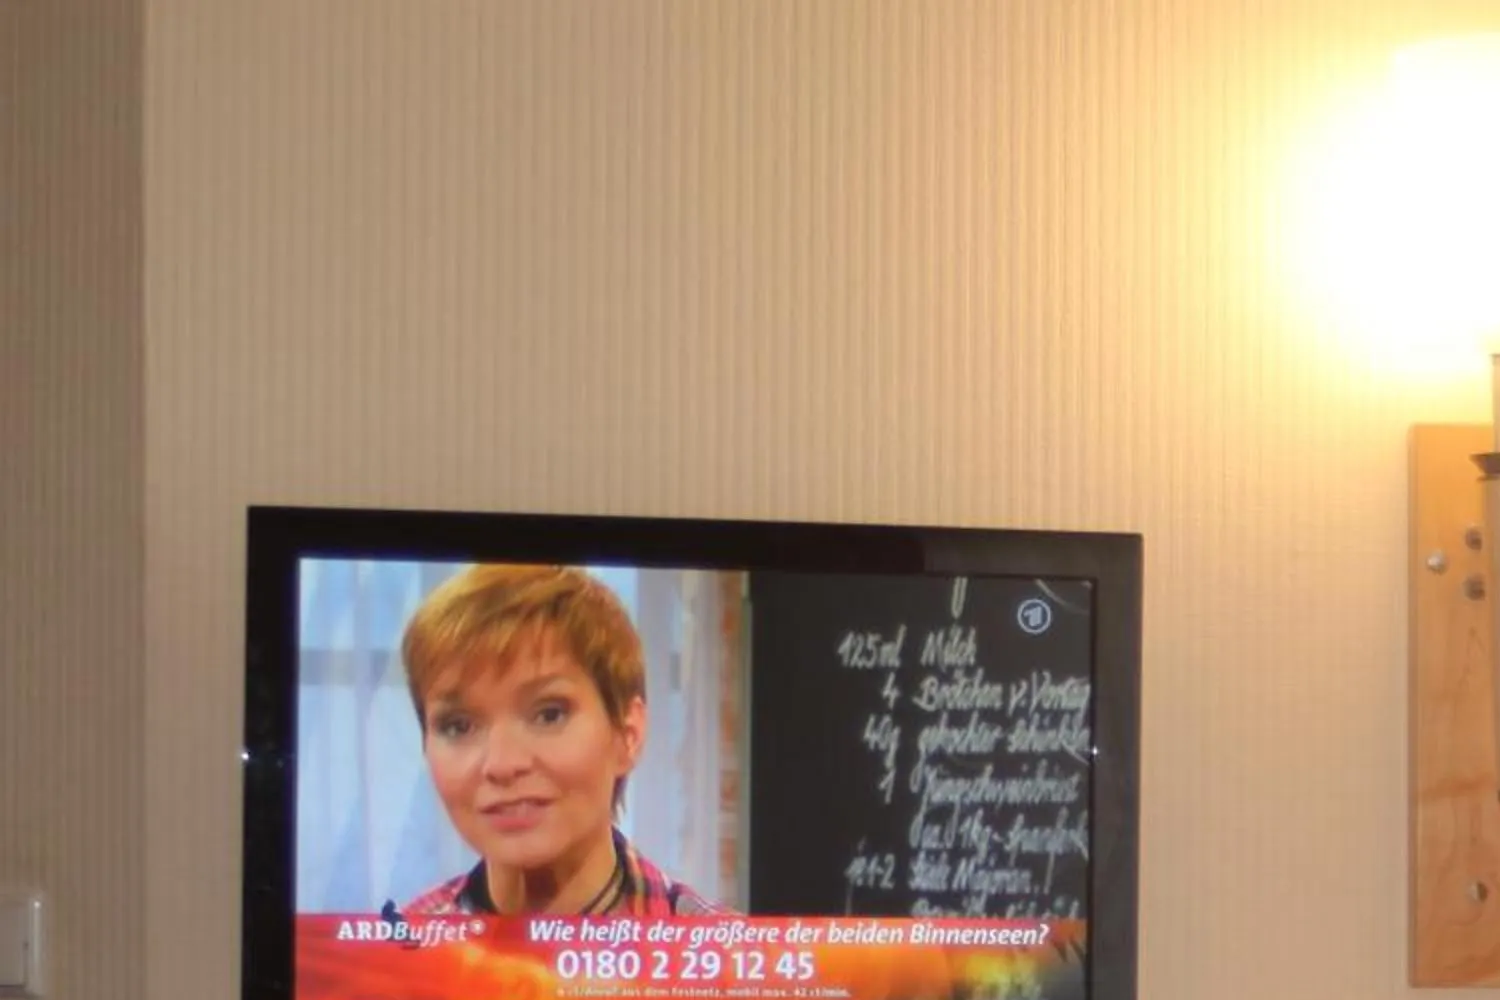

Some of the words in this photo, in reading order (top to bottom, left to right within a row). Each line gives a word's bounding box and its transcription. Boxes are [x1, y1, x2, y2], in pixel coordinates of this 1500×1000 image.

[881, 671, 900, 709] 4
[530, 919, 575, 941] Wie
[580, 918, 642, 948] heißt
[647, 920, 686, 942] der
[689, 921, 779, 949] größere
[784, 922, 820, 944] der
[826, 923, 904, 945] beiden
[909, 923, 1051, 945] Binnenseen?
[557, 950, 641, 979] 0180
[651, 951, 670, 979] 2
[680, 951, 722, 980] 29
[731, 952, 765, 980] 12
[775, 952, 816, 980] 45
